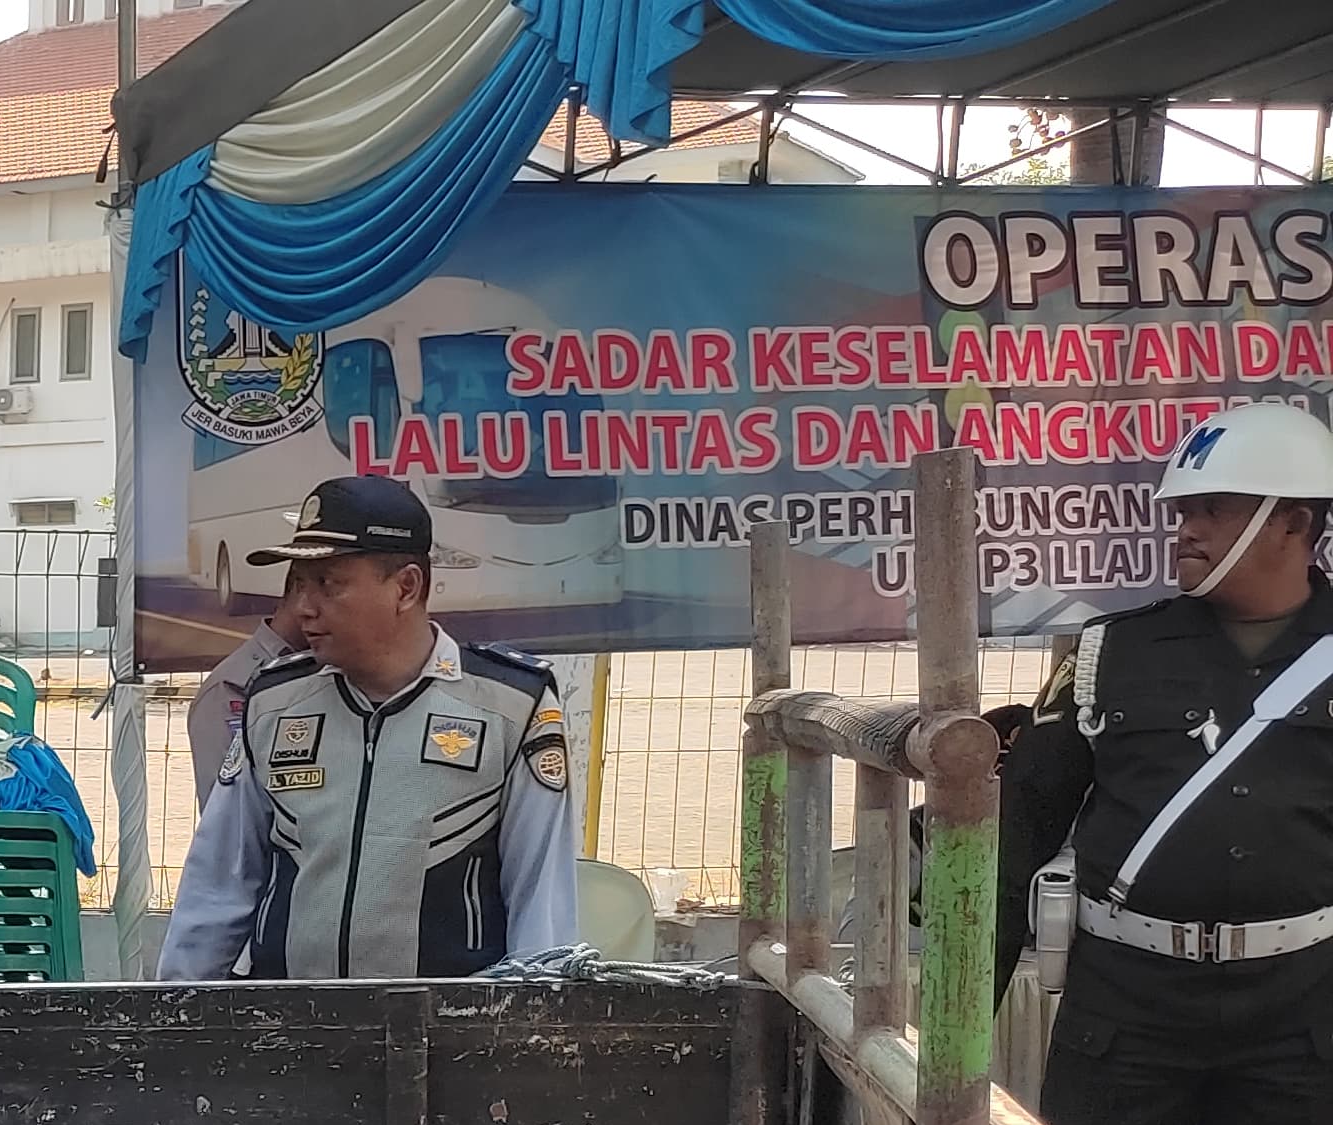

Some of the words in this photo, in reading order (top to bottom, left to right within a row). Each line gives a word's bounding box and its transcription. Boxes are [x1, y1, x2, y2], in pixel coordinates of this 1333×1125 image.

[508, 332, 735, 391] SADAR
[751, 324, 1223, 388] KESELAMATAN
[1235, 323, 1333, 382] DA
[230, 392, 251, 406] JAWA
[253, 391, 278, 404] TIMUR
[190, 407, 211, 427] JER
[212, 420, 253, 441] BASUKI
[255, 422, 289, 441] MAWA
[289, 404, 315, 428] BEYA
[351, 414, 529, 478] LALU
[547, 412, 778, 473] LINTAS
[796, 407, 935, 467] DAN
[984, 546, 1039, 588] P3
[1054, 542, 1153, 583] LLAJ
